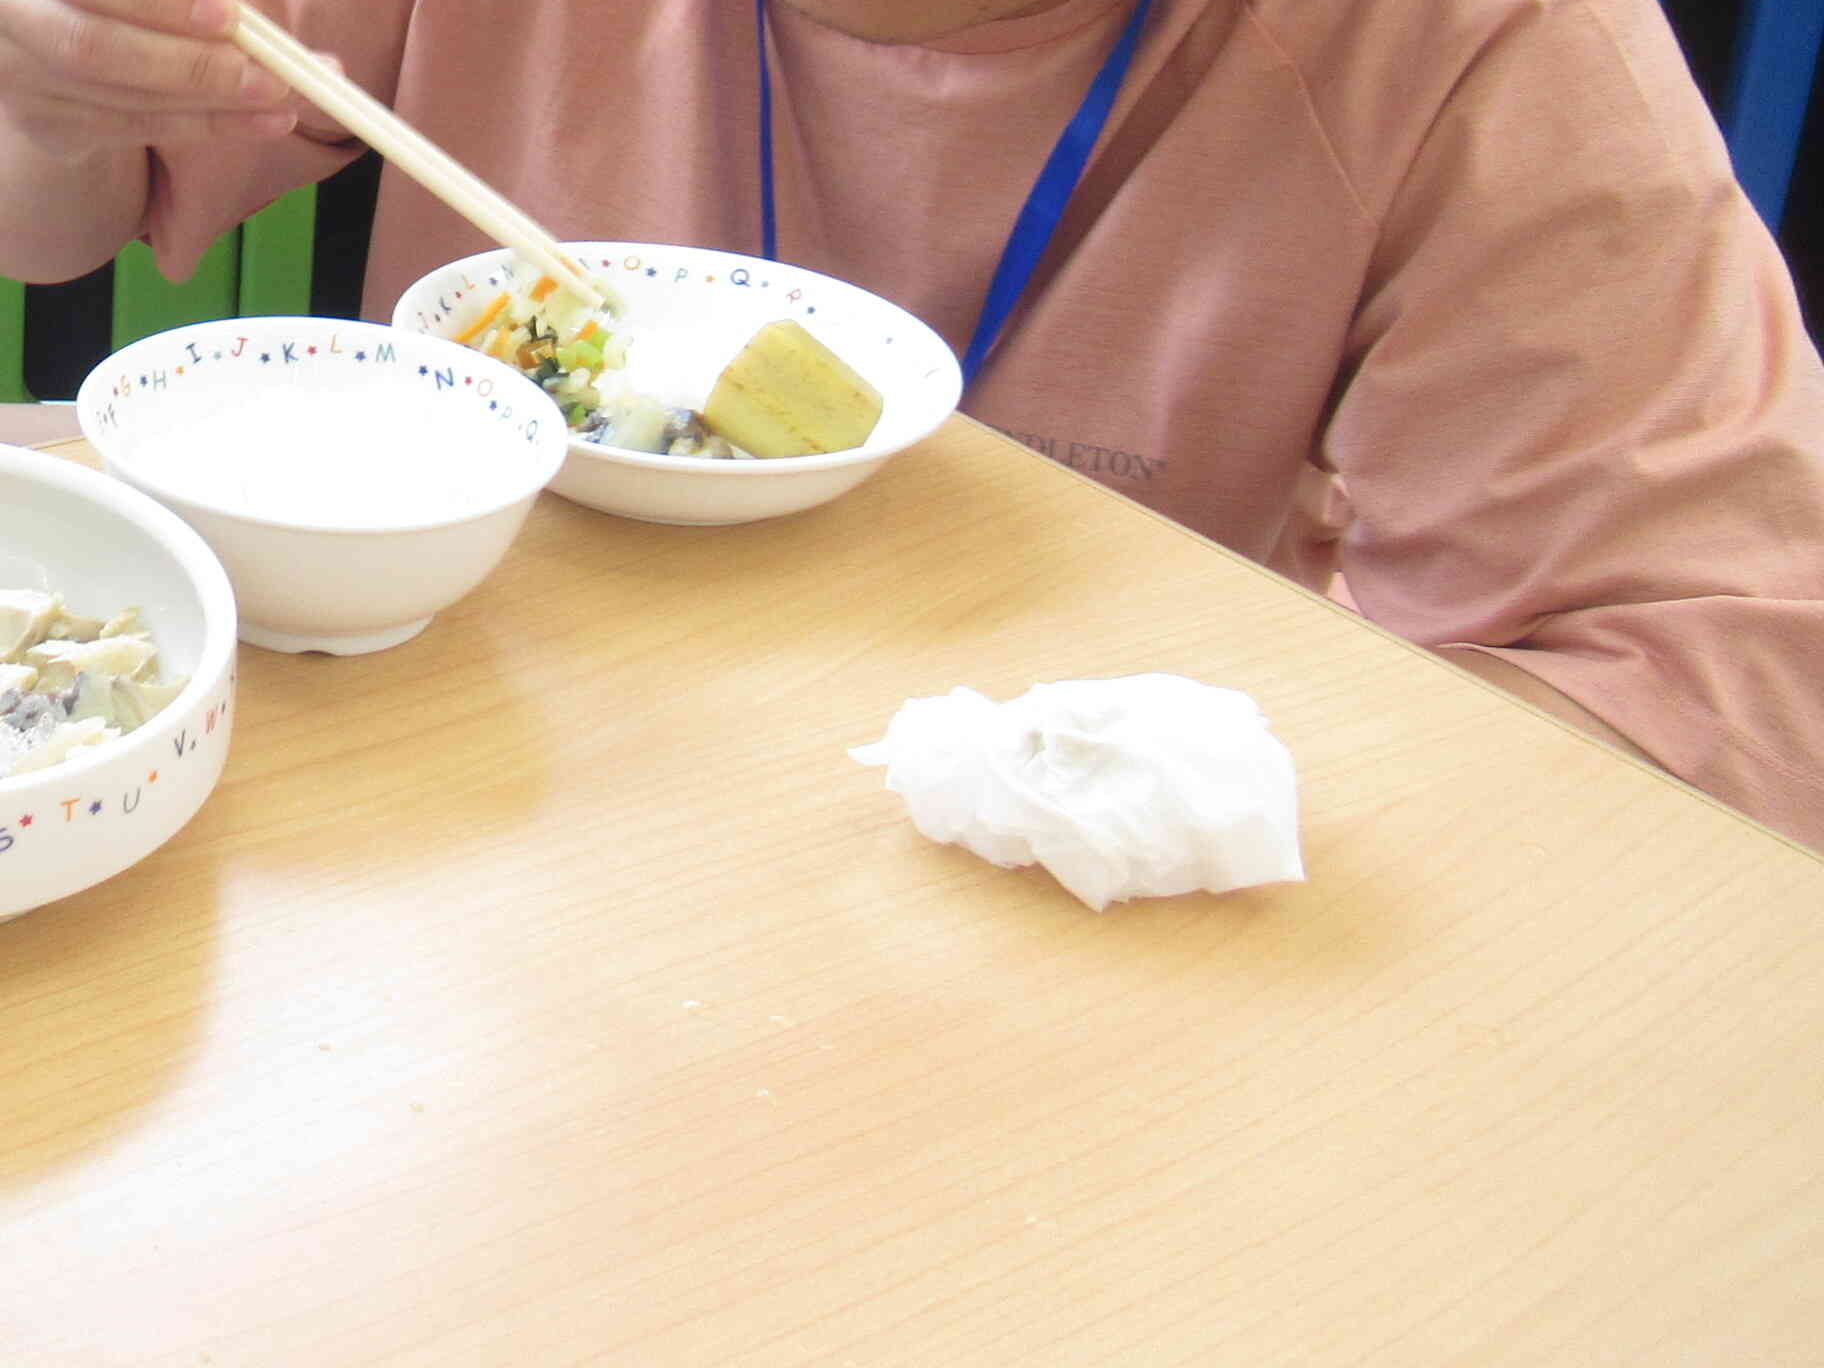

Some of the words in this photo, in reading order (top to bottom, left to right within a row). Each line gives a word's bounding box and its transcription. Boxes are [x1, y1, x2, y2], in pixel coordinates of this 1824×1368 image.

[731, 268, 751, 288] Q
[153, 369, 168, 391] H
[231, 336, 249, 358] J
[282, 341, 299, 365] K
[331, 334, 344, 353] L
[375, 342, 396, 364] M
[434, 367, 455, 391] N
[477, 379, 494, 398] O
[60, 798, 81, 823] T
[122, 787, 142, 815] U
[173, 728, 187, 759] V
